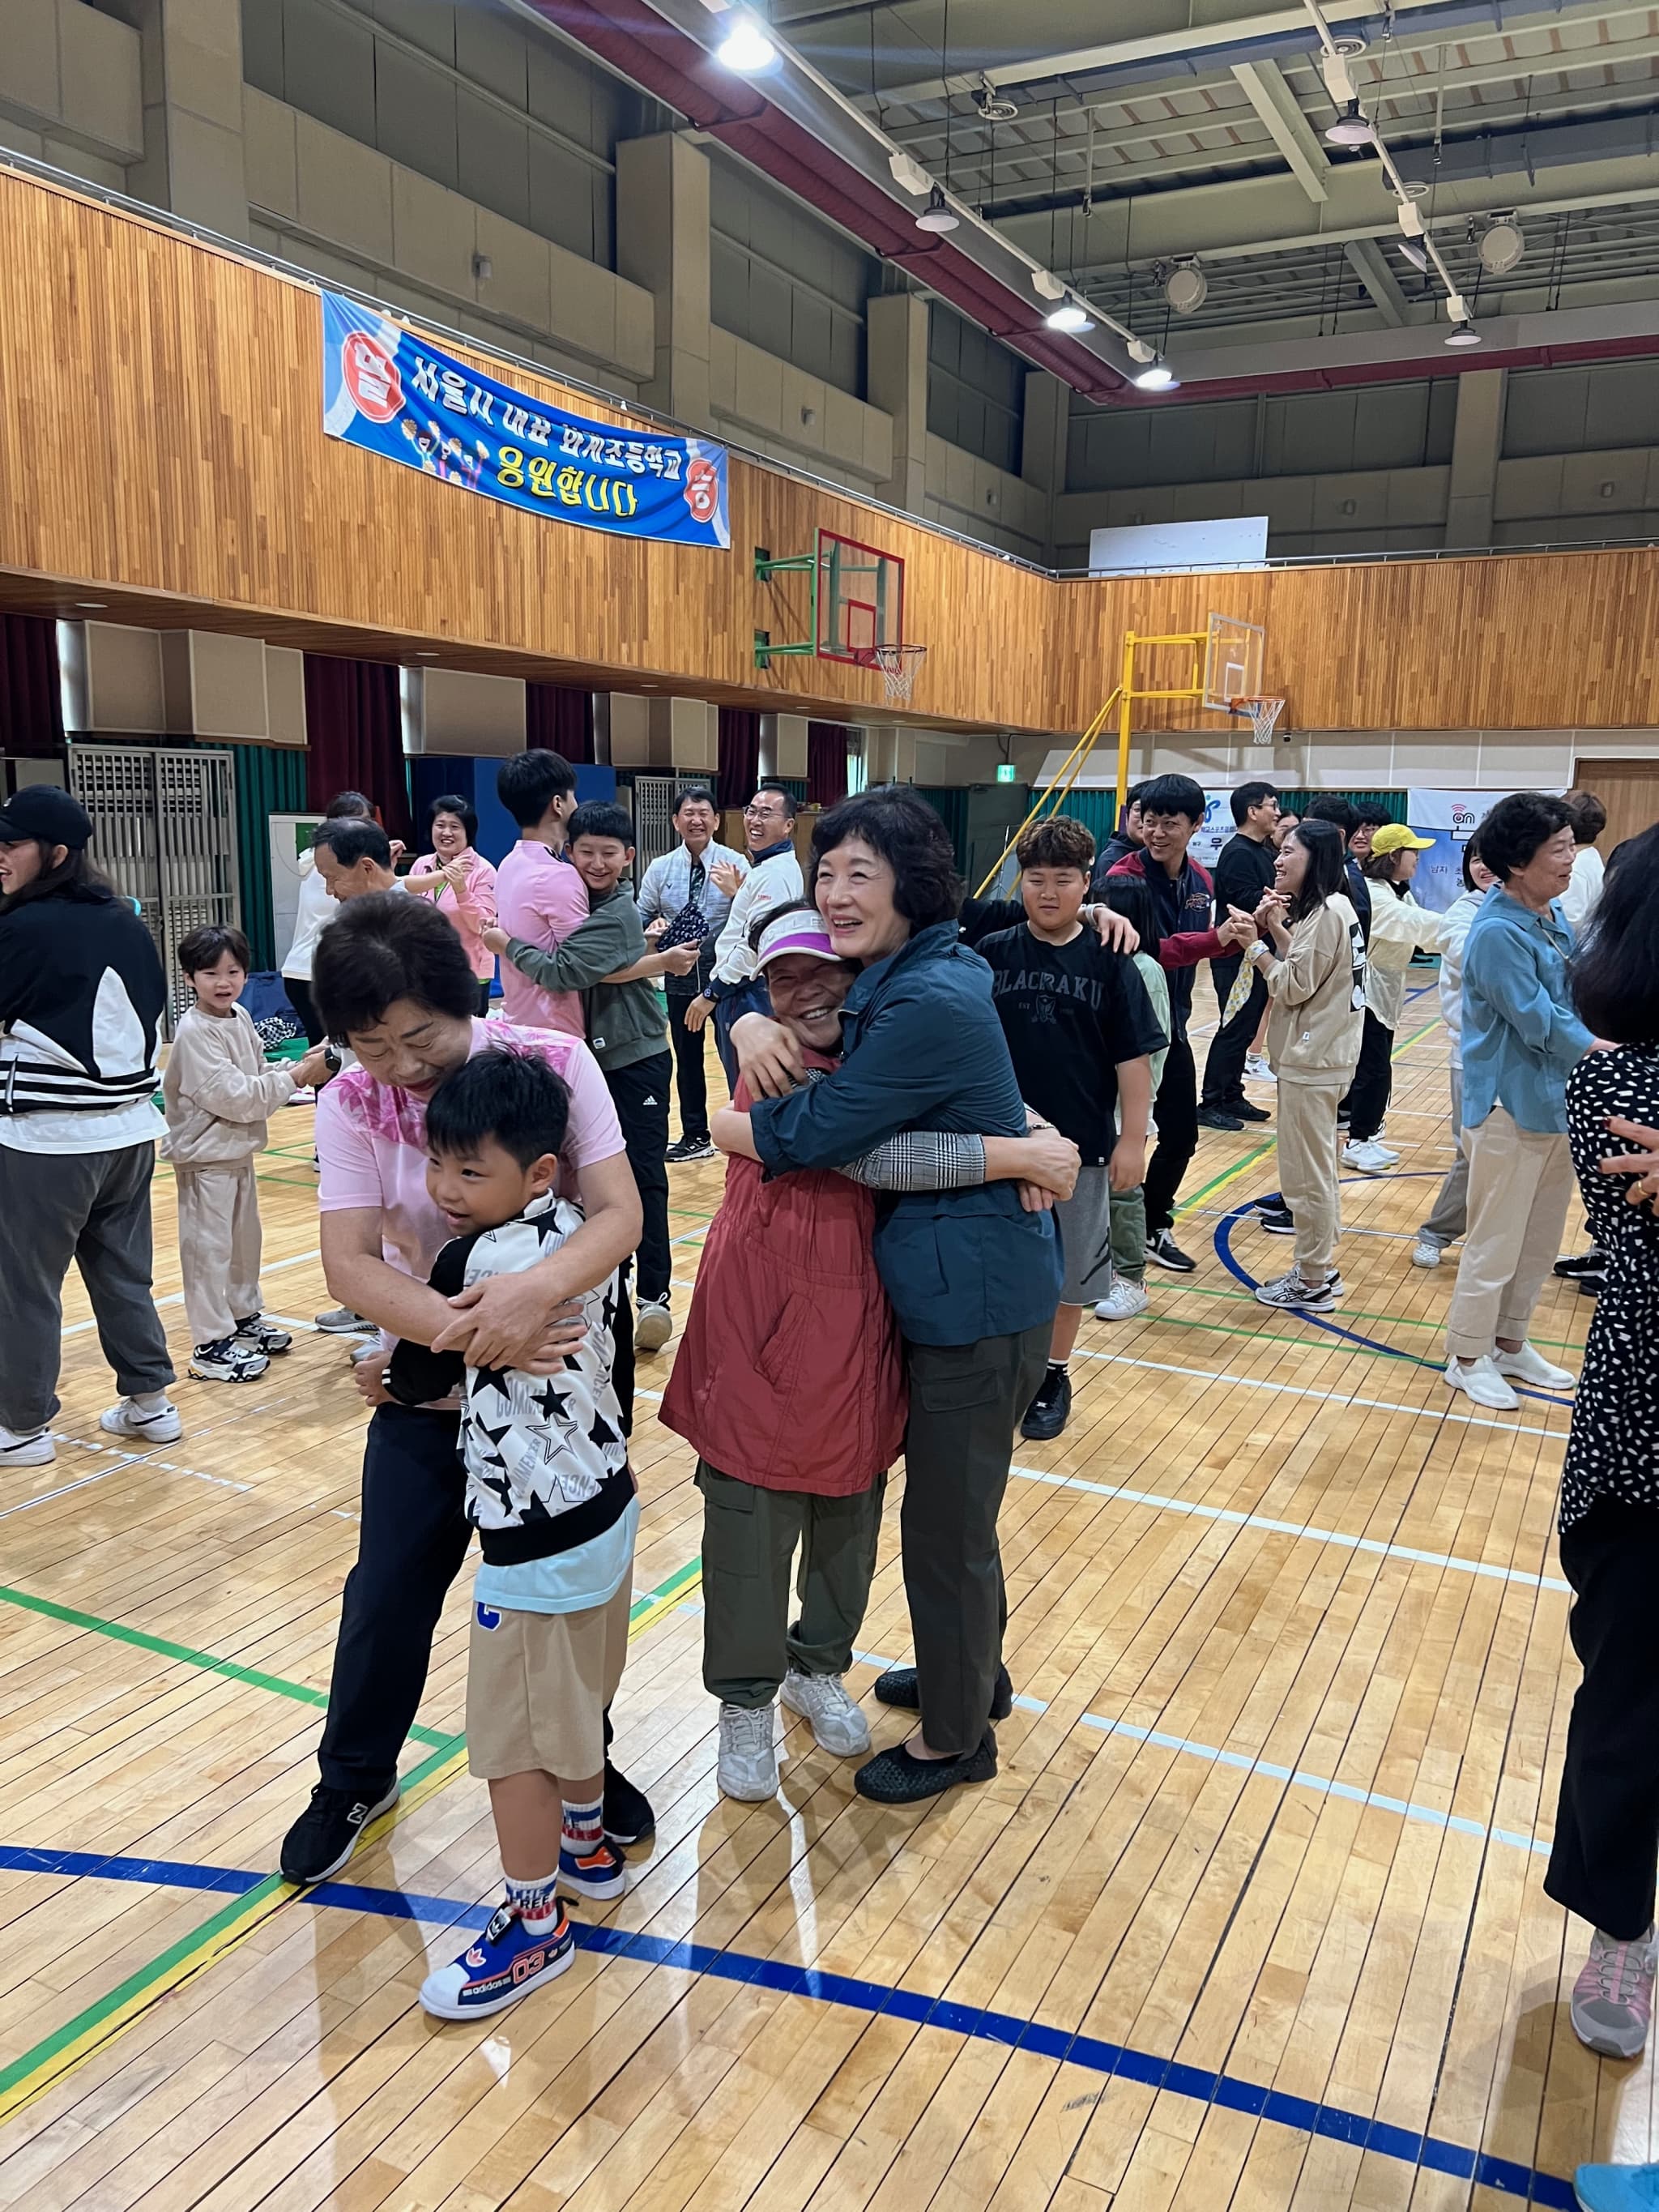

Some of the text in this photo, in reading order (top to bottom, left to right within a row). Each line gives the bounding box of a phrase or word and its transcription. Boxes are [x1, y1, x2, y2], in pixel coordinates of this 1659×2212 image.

[411, 357, 495, 426] 서울시
[502, 403, 552, 447] 대표
[498, 446, 638, 517] 응원합니다
[513, 1950, 545, 1984] 03
